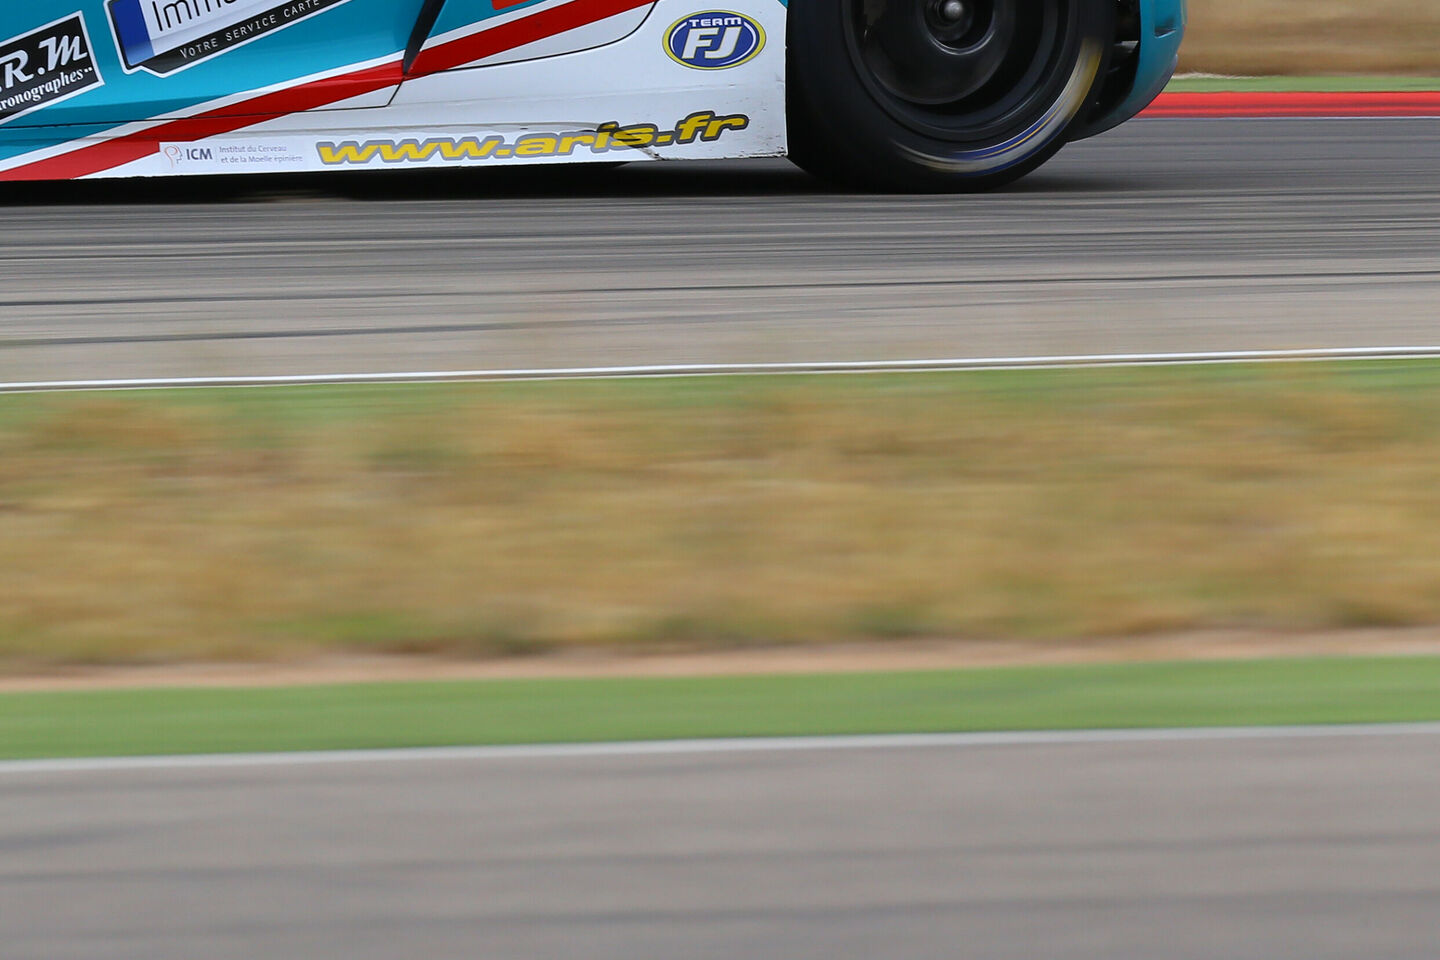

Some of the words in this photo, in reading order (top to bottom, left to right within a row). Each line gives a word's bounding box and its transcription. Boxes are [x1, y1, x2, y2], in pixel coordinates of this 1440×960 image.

[688, 16, 742, 27] TEAM
[179, 37, 218, 59] VOTRE
[225, 14, 277, 42] SERVICE
[681, 26, 743, 59] FJ
[317, 110, 749, 166] www.aris.fr
[186, 148, 213, 160] ICM
[219, 145, 246, 153] Institut
[247, 145, 257, 153] du
[221, 156, 228, 164] et
[230, 155, 239, 163] de
[240, 155, 247, 163] la
